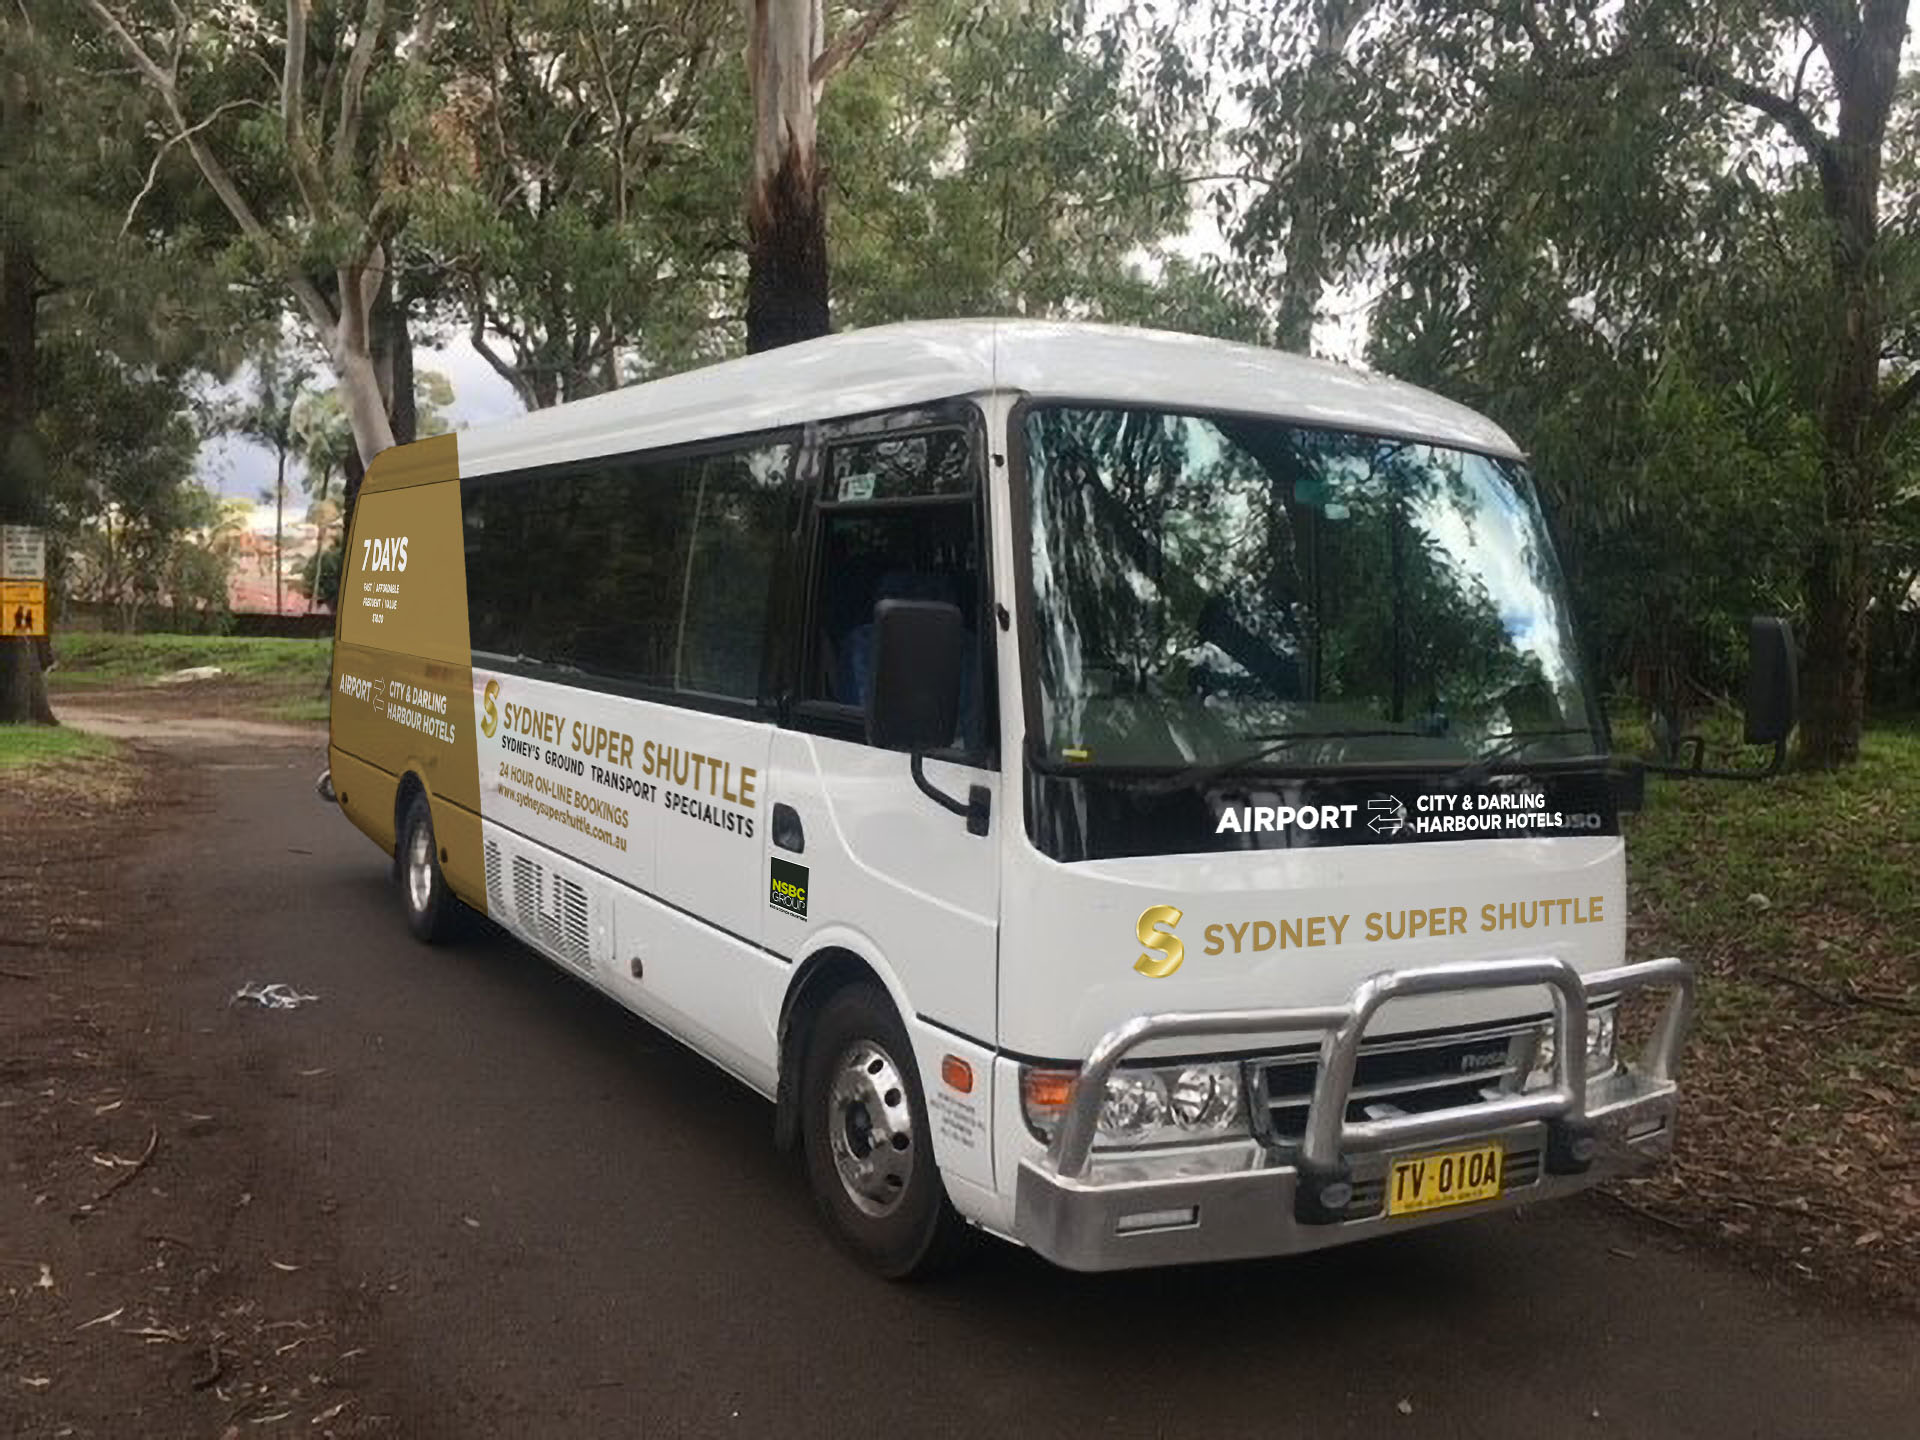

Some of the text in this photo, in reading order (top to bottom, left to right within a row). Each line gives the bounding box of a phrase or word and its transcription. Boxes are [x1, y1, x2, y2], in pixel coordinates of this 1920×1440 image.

[361, 536, 409, 573] 7 DAYS
[339, 673, 372, 703] AIRPORT
[389, 680, 447, 715] CITY & DARLING
[386, 701, 456, 744] HARBOUR HOTELS
[481, 679, 757, 809] S SYDNEY SUPER SHUTTLE
[499, 761, 630, 829] 24 HOUR ON-LINE BOOKINGS
[501, 735, 755, 838] SYDNEY'S GROUND TRANSPORT SPECIALISTS
[1416, 793, 1546, 812] CITY & DARLING
[497, 782, 629, 853] www.sydneysupershuttle.com.au
[1215, 804, 1358, 834] AIRPORT
[1416, 812, 1563, 834] HARBOUR HOTELS
[772, 878, 806, 901] NSBC
[772, 890, 806, 911] GROUP
[1133, 896, 1605, 979] S SYDNEY SUPER SHUTTLE
